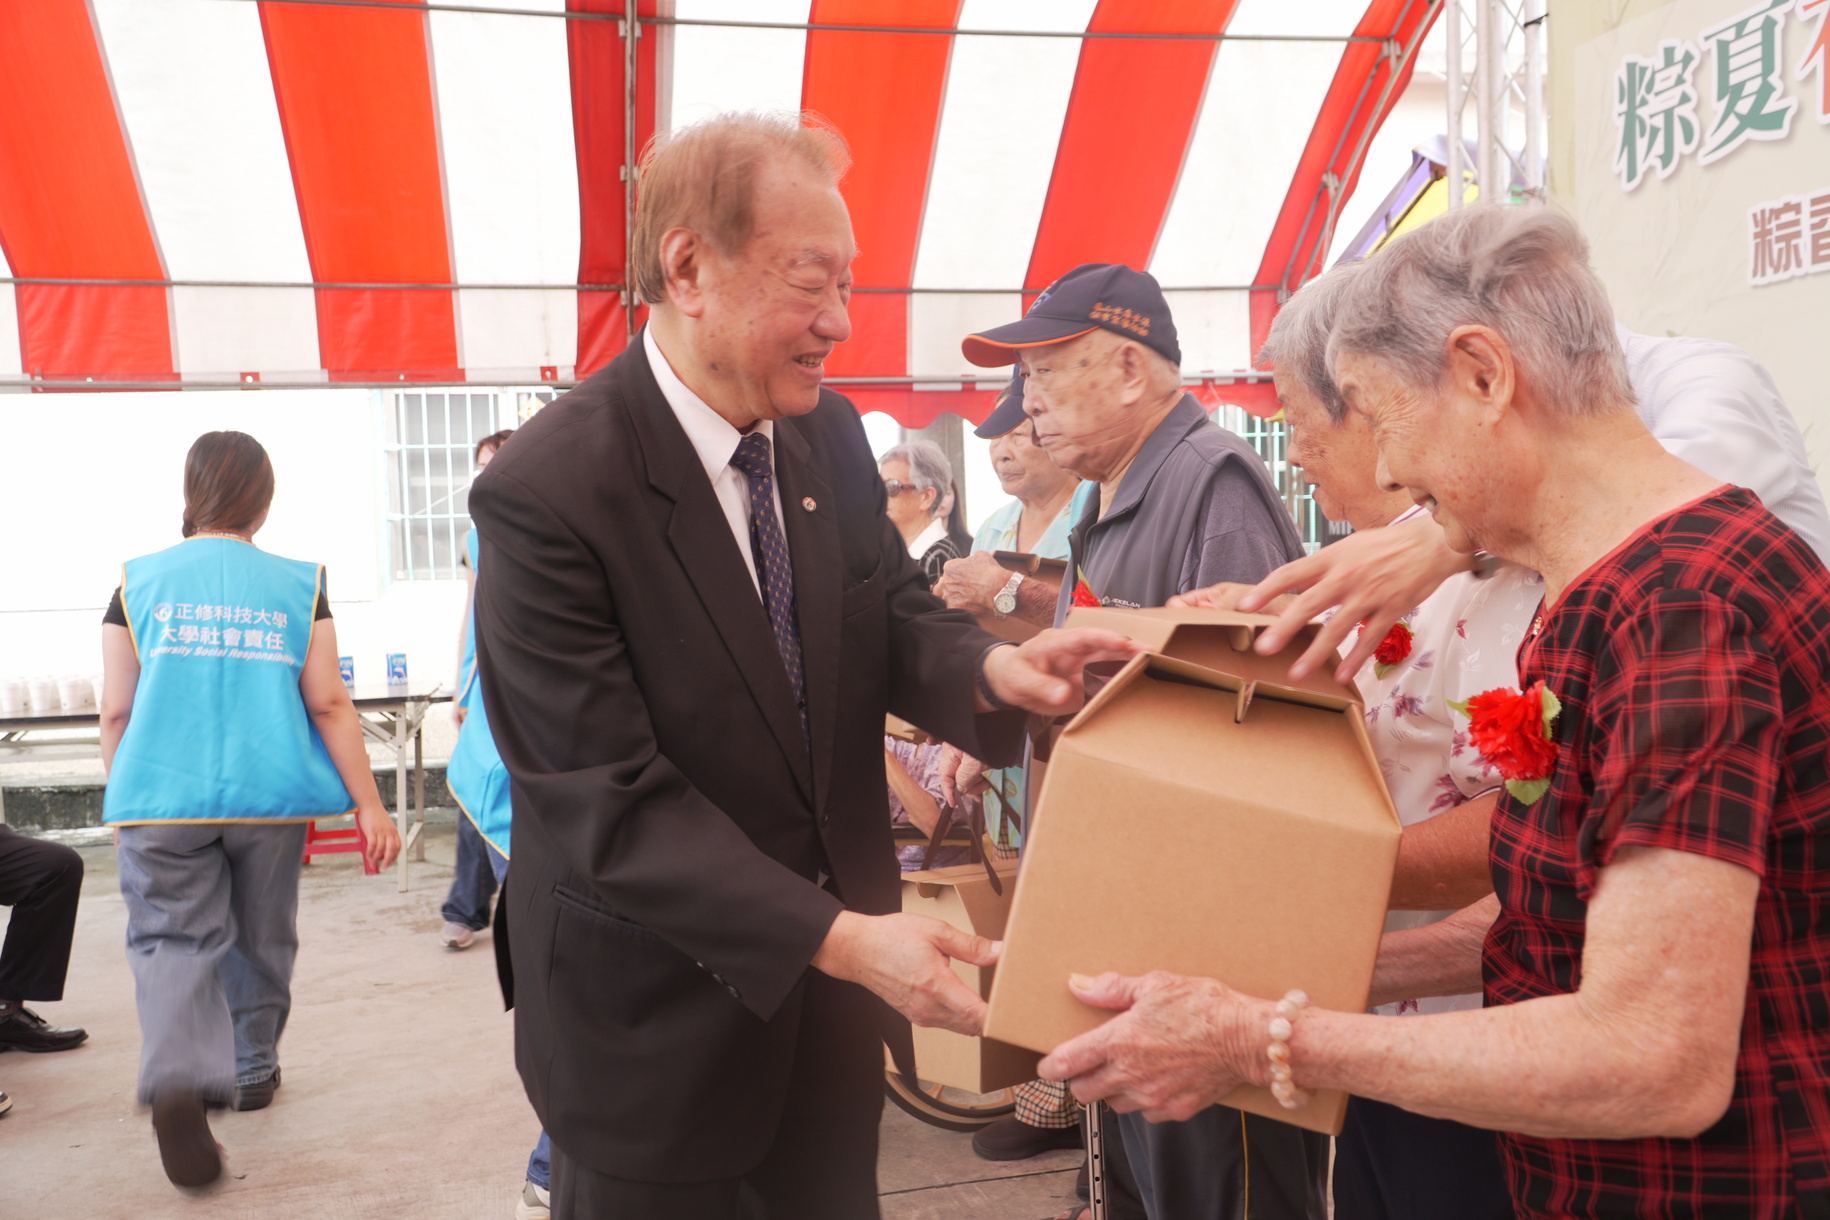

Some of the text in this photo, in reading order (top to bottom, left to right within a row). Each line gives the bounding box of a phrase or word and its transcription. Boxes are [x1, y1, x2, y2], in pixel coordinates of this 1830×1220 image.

[174, 602, 288, 629] 正修科技大學
[160, 623, 284, 651] 大學社會責任
[193, 645, 228, 658] Social
